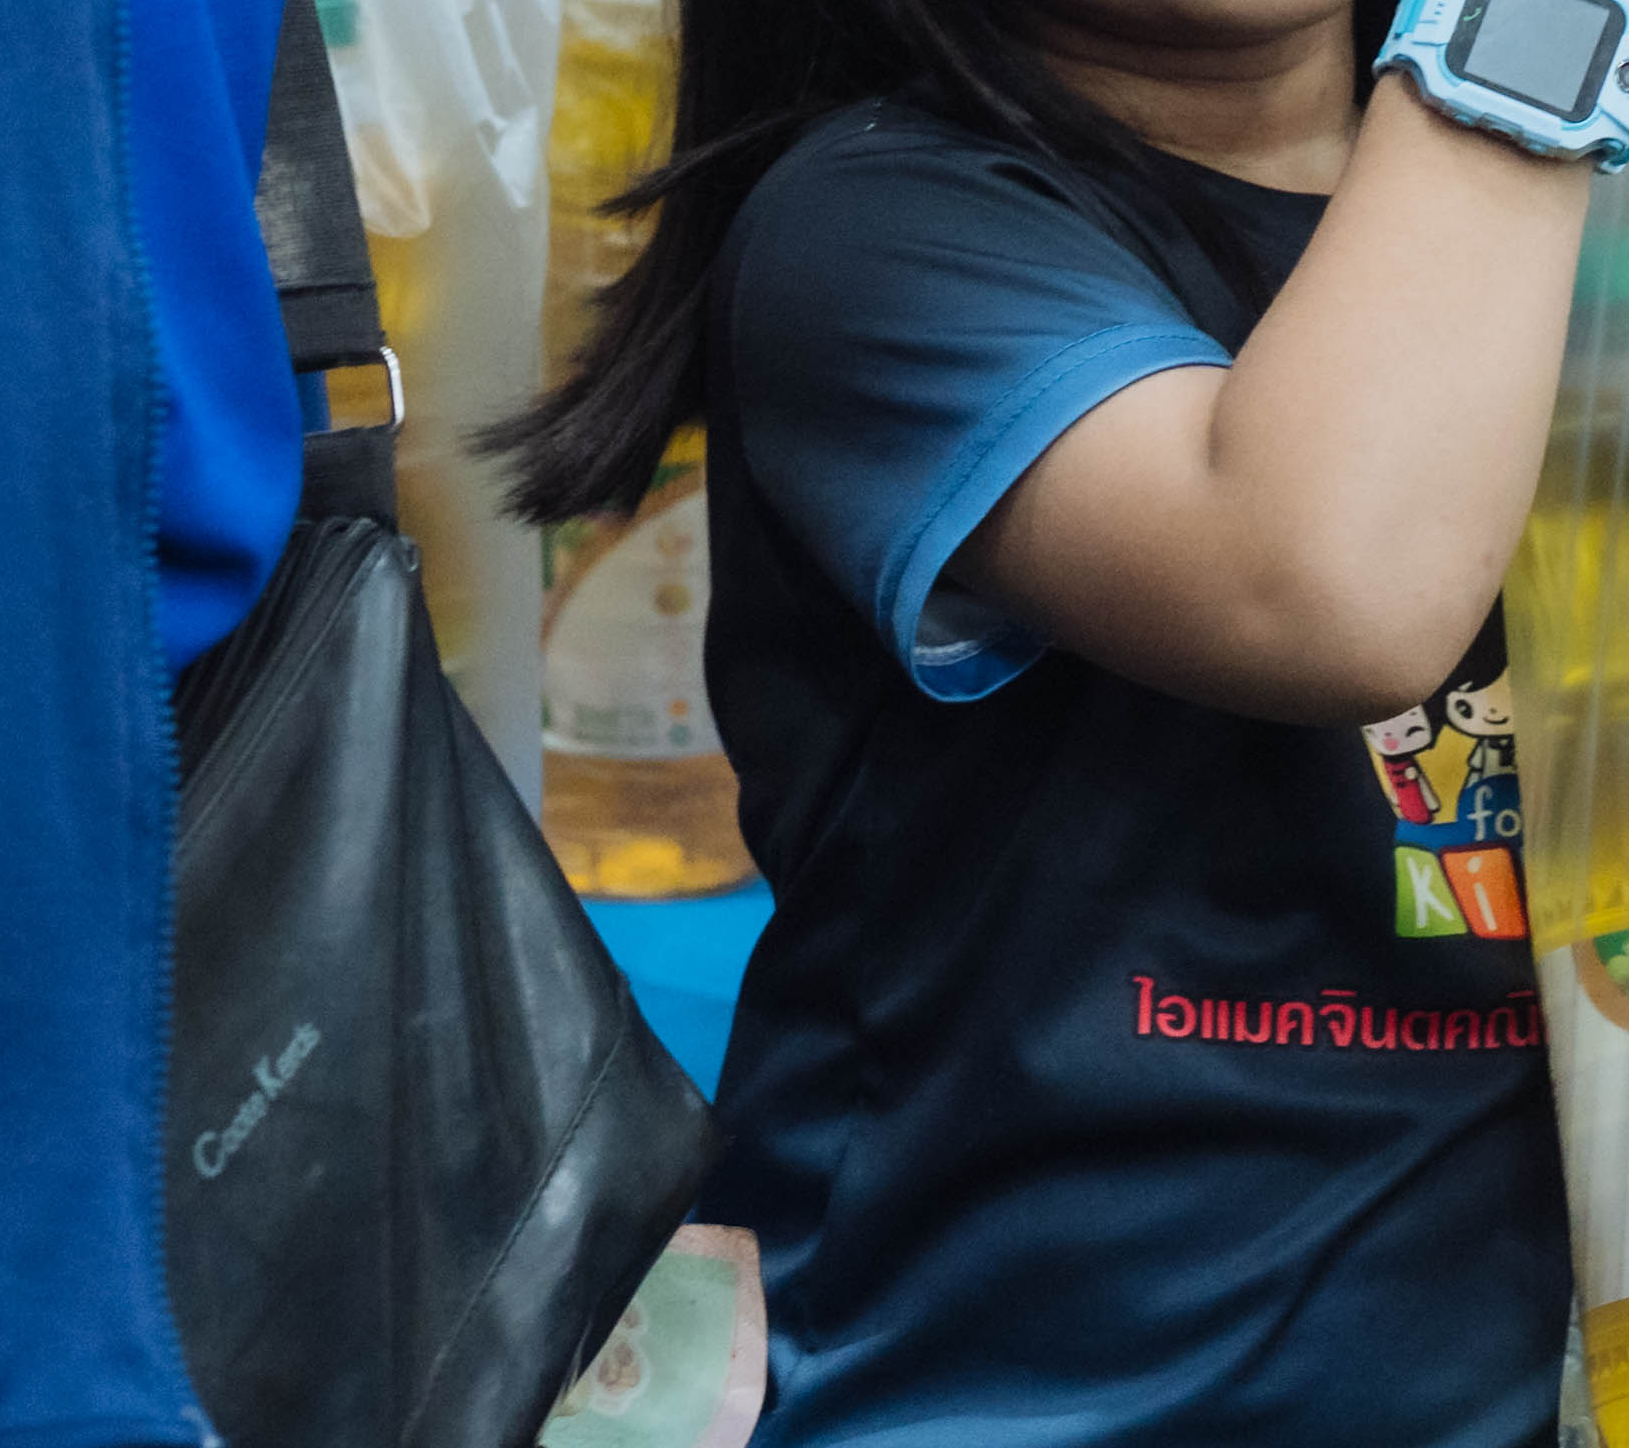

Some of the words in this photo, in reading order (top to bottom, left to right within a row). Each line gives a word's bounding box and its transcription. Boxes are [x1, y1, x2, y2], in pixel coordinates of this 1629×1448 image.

[1467, 786, 1521, 841] fo
[1131, 975, 1546, 1052] ไอแมคจินตคณิ
